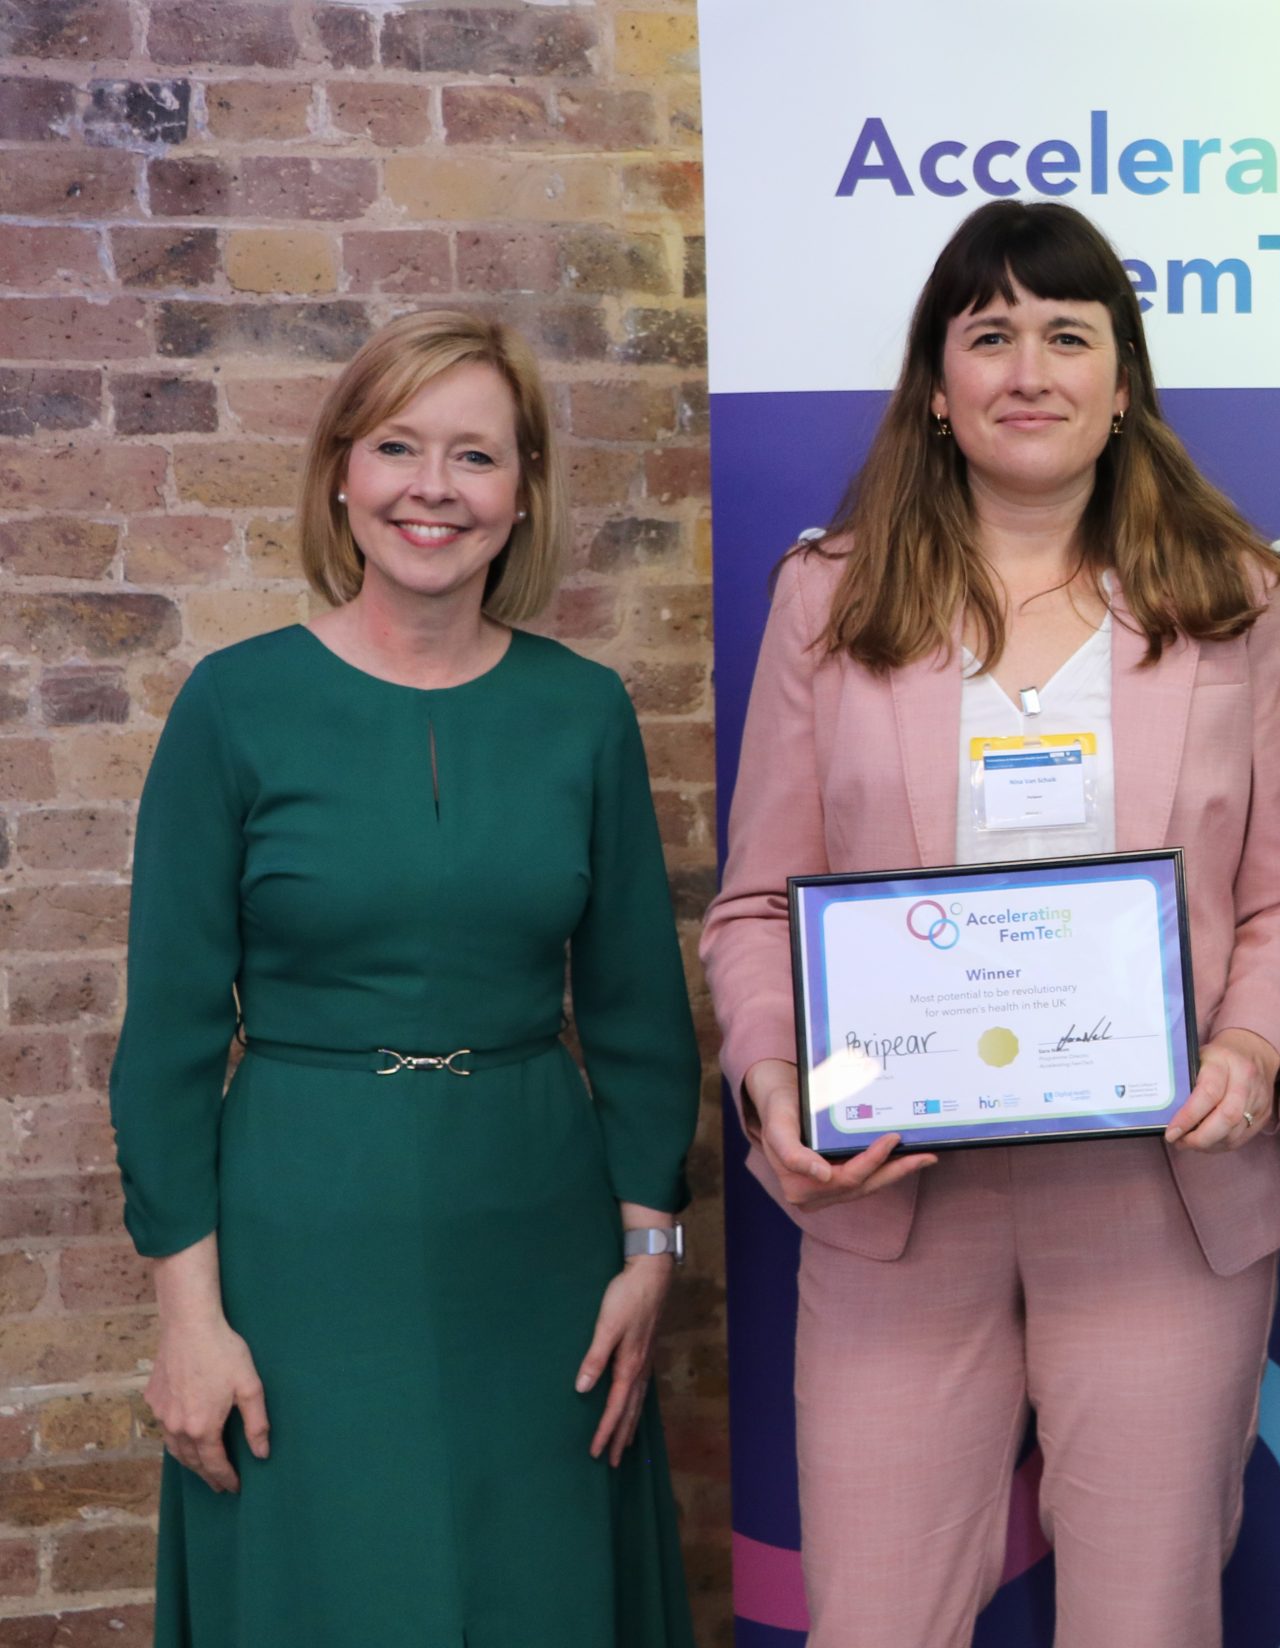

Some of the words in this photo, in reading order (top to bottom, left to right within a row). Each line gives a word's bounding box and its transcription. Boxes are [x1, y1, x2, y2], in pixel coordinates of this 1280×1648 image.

[966, 907, 1072, 926] Accelerating
[999, 923, 1073, 943] FemTech
[966, 967, 1022, 982] Winner
[910, 993, 935, 1004] Most
[937, 989, 982, 1003] potential
[984, 990, 994, 999] to
[996, 988, 1010, 998] be
[1012, 984, 1078, 996] revolutionary
[925, 1007, 940, 1018] for
[942, 1006, 986, 1017] women's
[988, 1002, 1019, 1013] health
[1021, 1002, 1031, 1011] in
[1033, 1001, 1050, 1010] the
[1052, 999, 1067, 1008] UK
